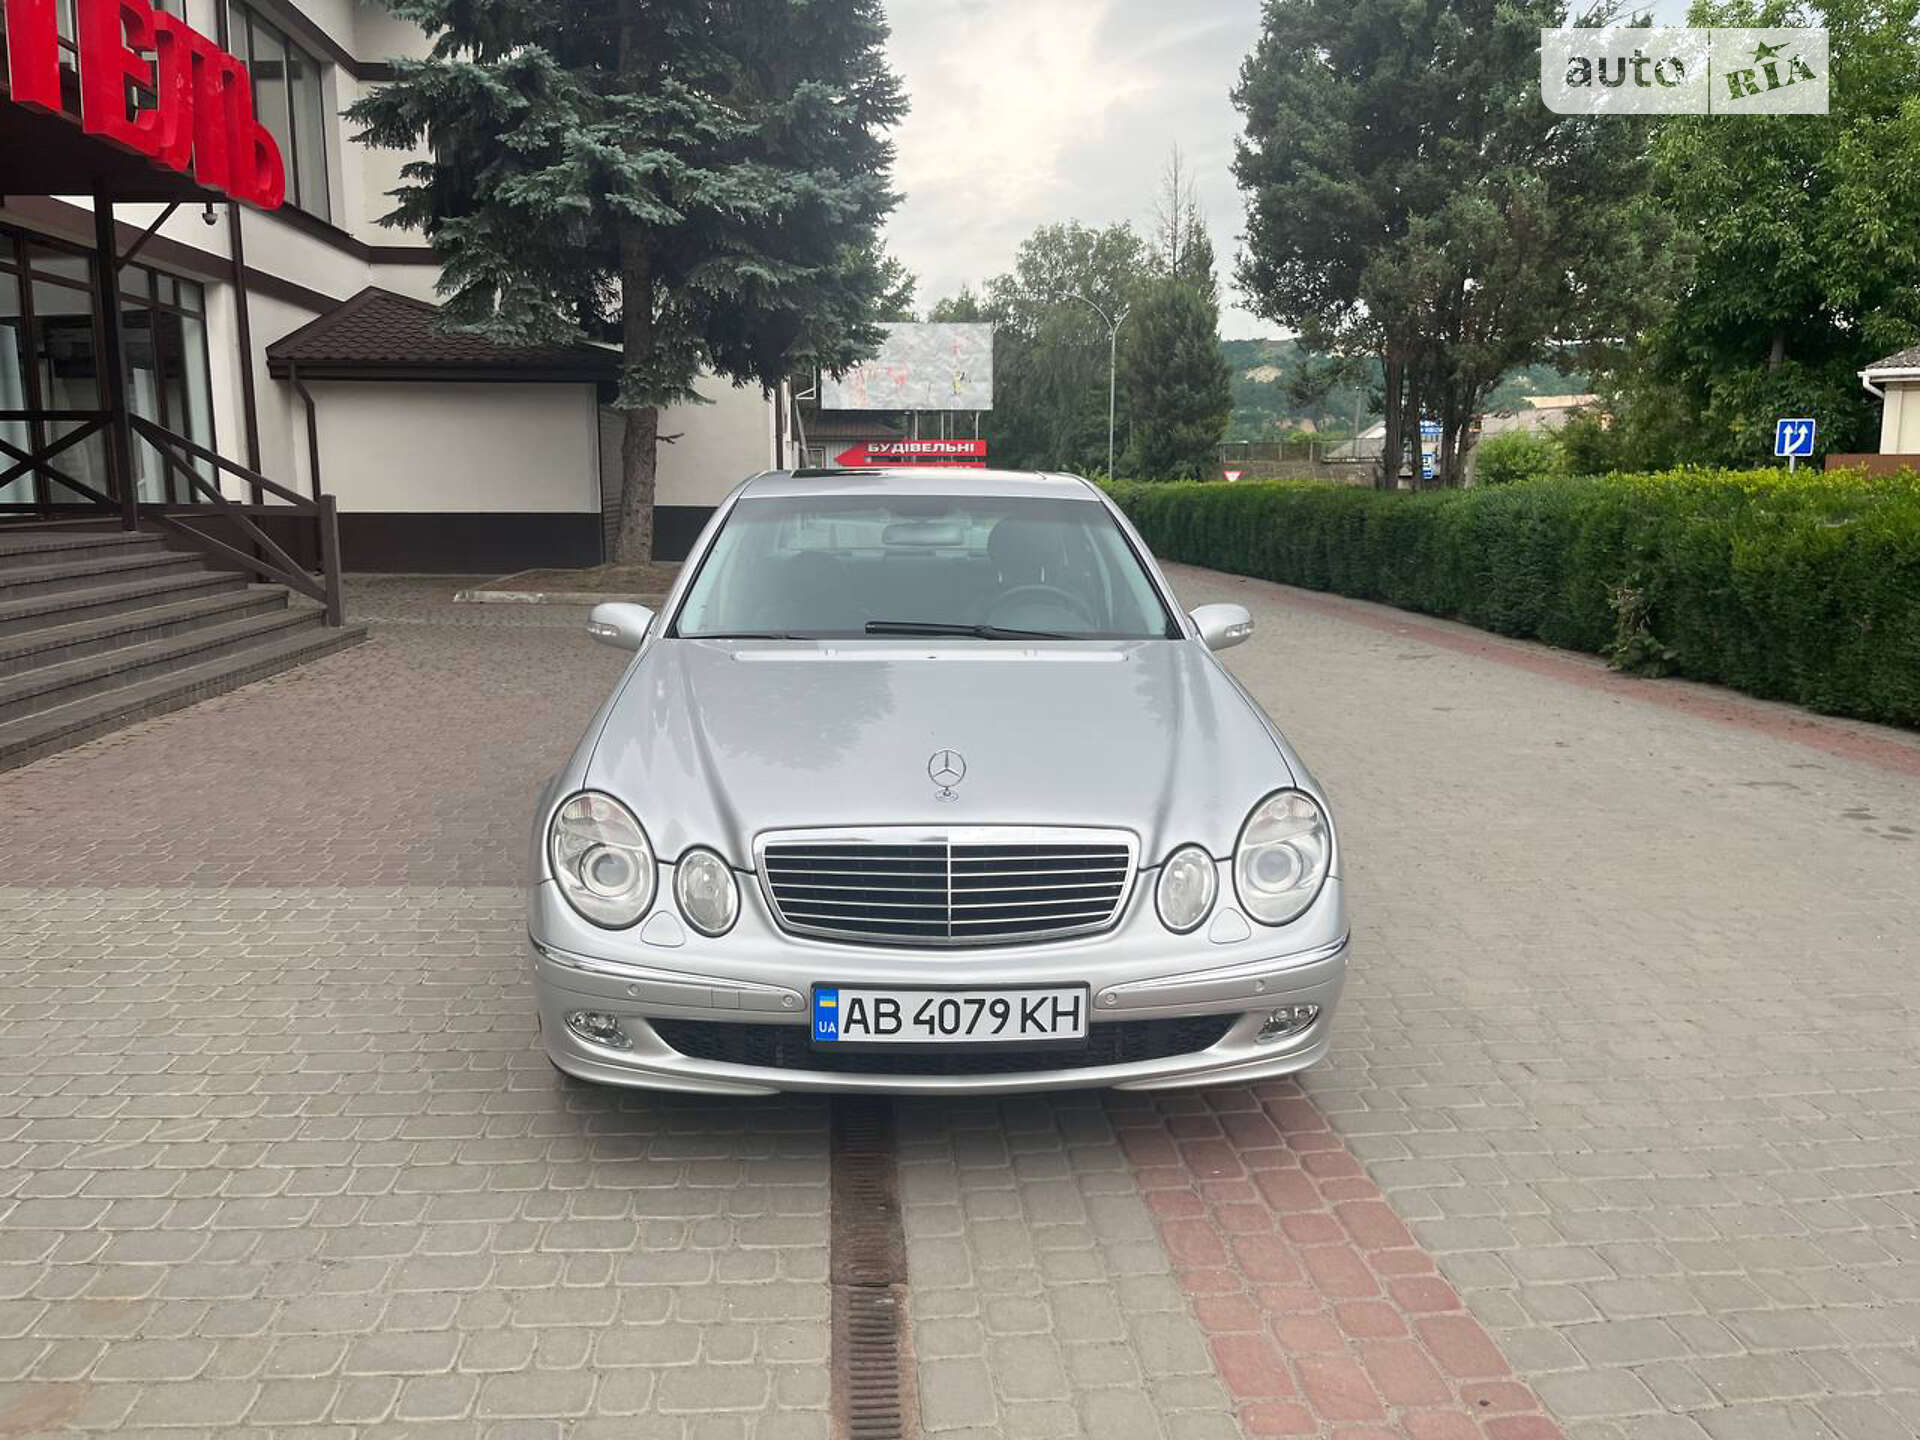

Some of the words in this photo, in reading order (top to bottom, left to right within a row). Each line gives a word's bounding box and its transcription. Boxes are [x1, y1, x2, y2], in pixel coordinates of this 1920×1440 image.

[868, 443, 974, 453] БУДІВЕЛЬНІ
[843, 998, 902, 1034] AB
[913, 998, 1010, 1035] 4079
[1020, 995, 1080, 1034] KH
[818, 1021, 837, 1033] UA
